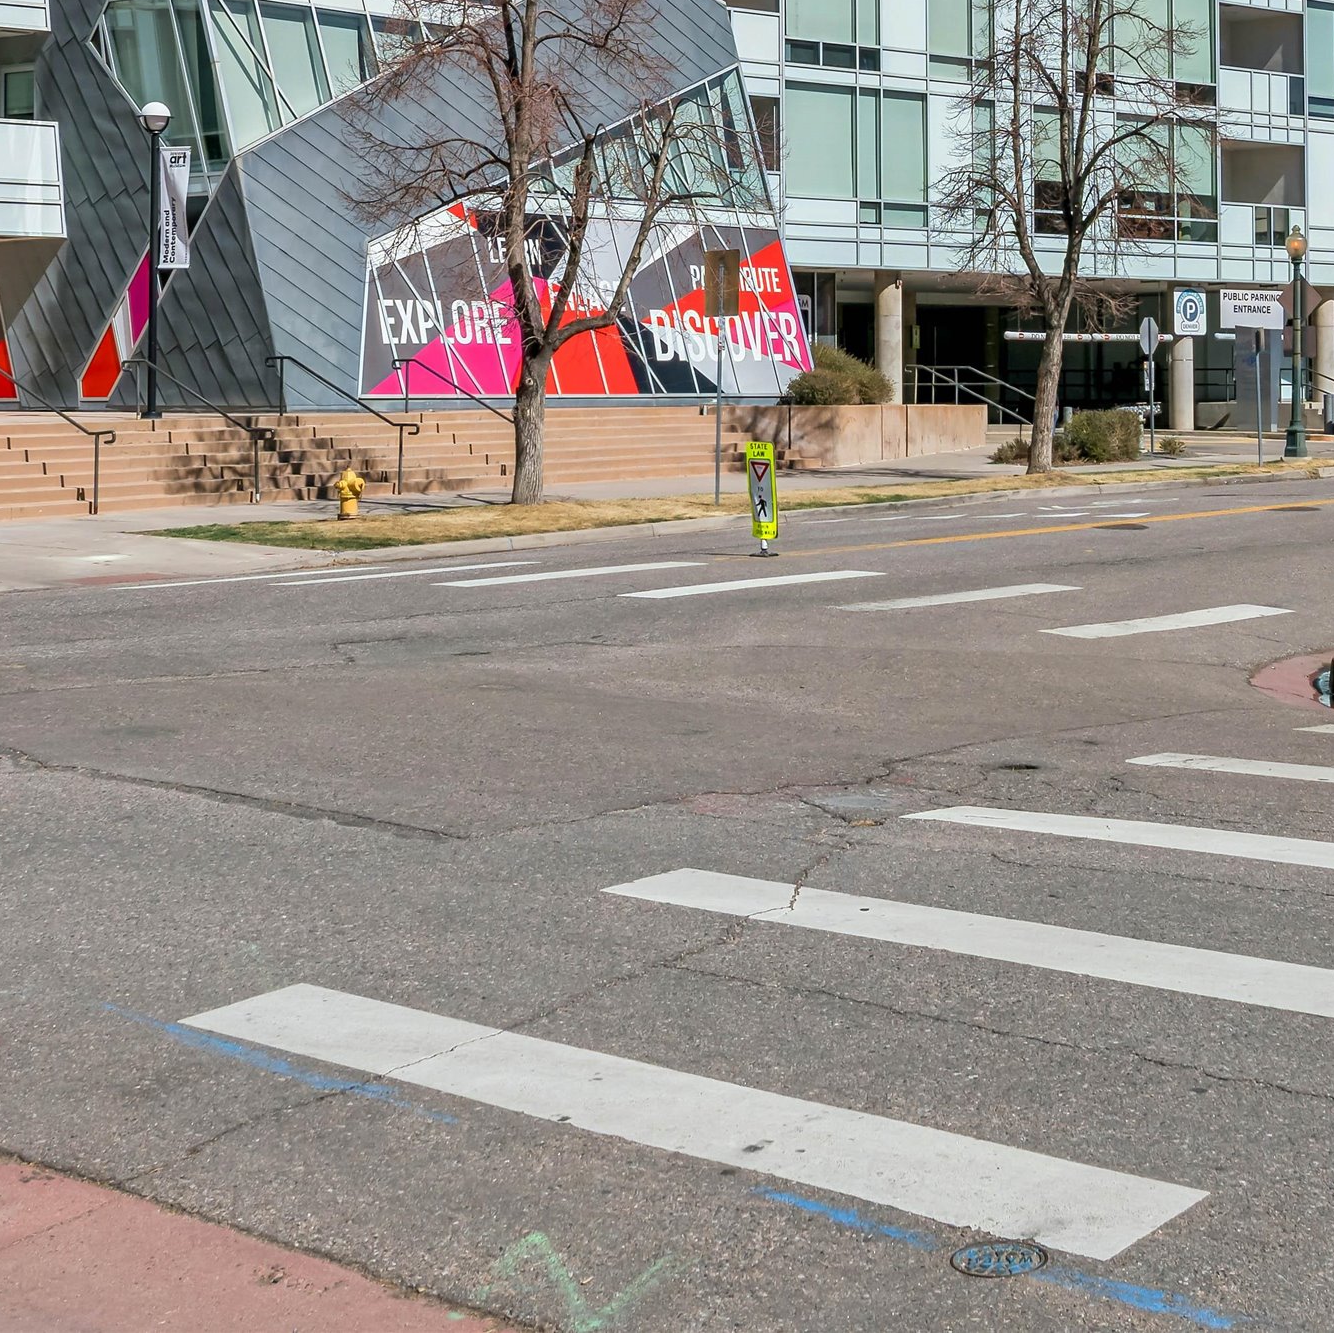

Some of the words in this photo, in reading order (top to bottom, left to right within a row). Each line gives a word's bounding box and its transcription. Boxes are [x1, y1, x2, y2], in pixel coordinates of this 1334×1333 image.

[169, 152, 187, 164] art
[169, 197, 178, 264] Contemporary
[162, 227, 170, 264] Modern
[487, 236, 543, 265] LERN
[1186, 302, 1196, 319] P
[1223, 292, 1249, 301] PUBLIC
[1233, 304, 1272, 314] ENTRANCE
[377, 299, 512, 345] EXPLORE
[649, 309, 802, 362] DISCOVER
